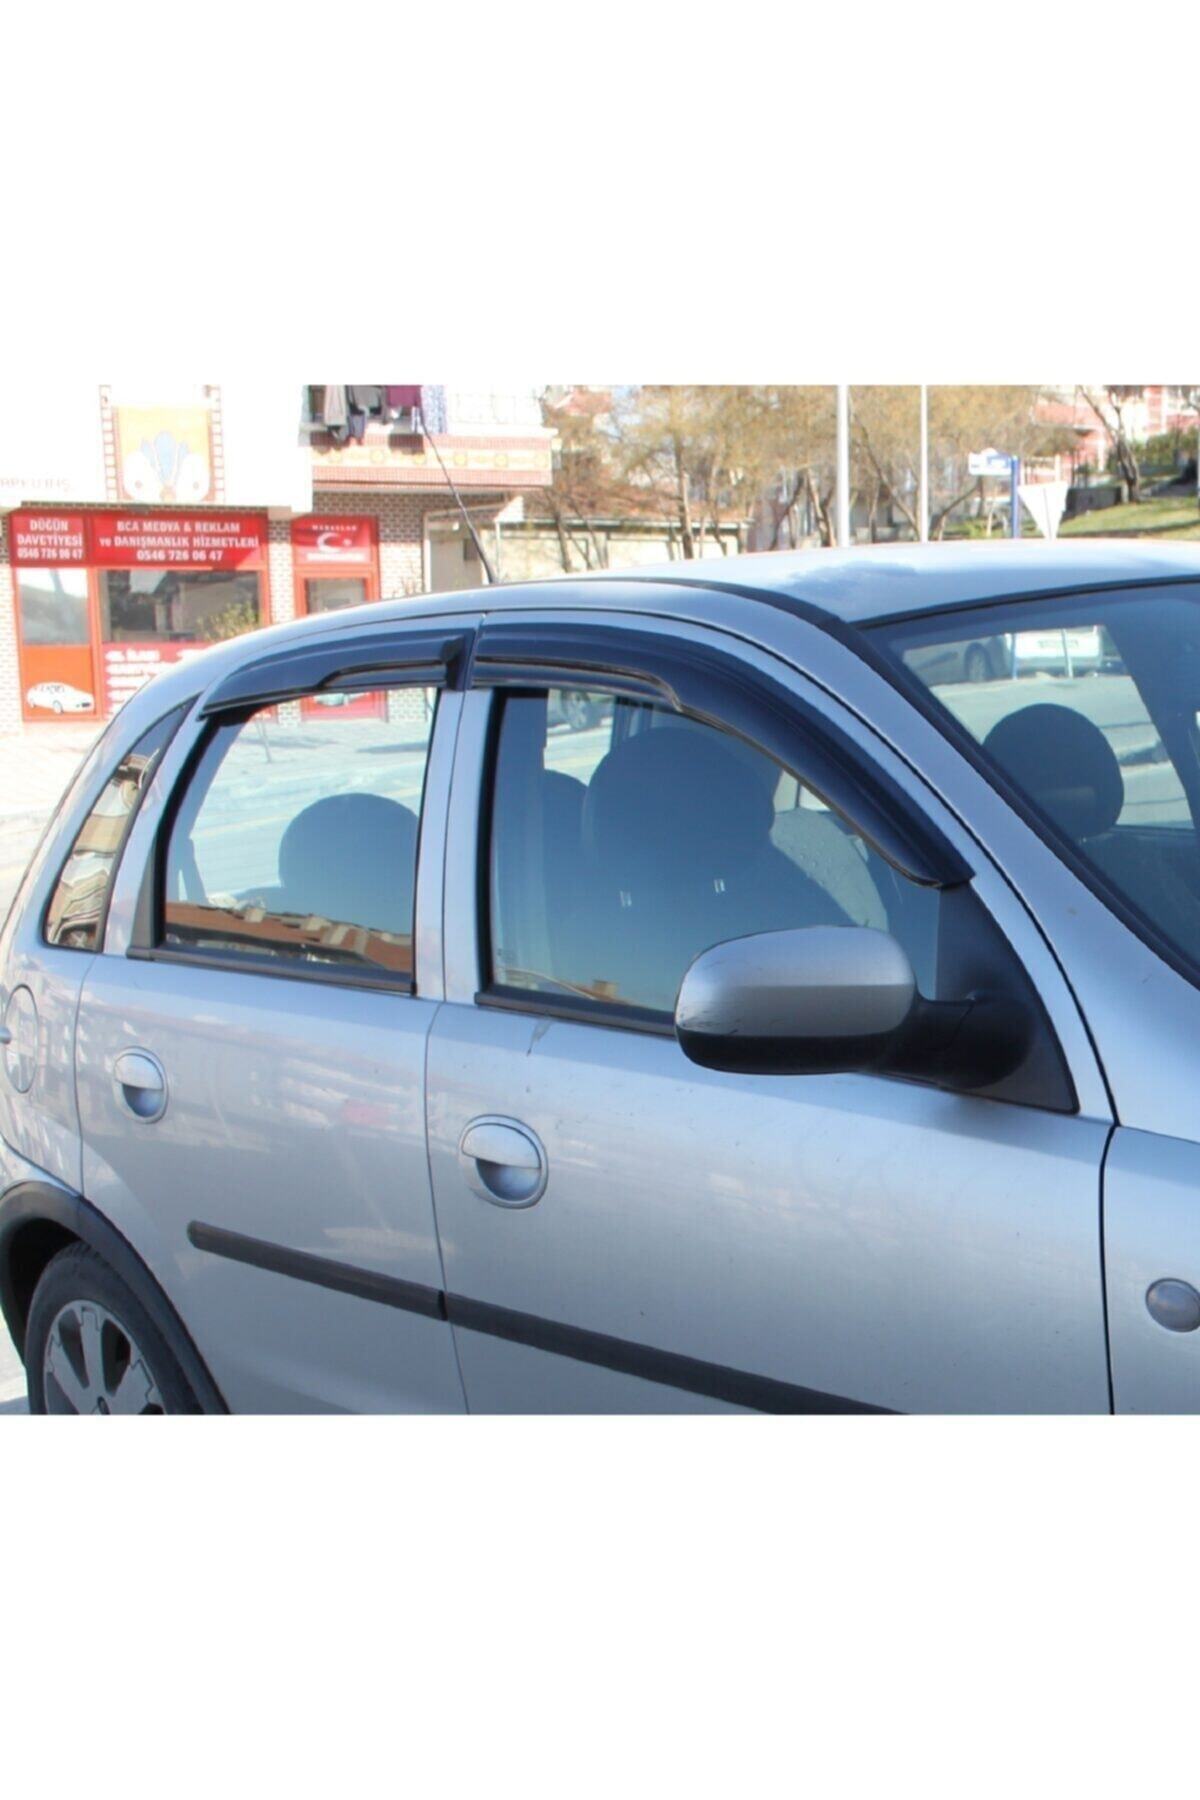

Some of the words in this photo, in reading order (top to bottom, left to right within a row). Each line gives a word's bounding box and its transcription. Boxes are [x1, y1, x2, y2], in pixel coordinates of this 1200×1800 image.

[143, 521, 180, 532] MEDYA
[195, 522, 240, 533] REKLAM
[99, 537, 111, 547] ve
[114, 536, 189, 548] DANIŞMANLIK
[193, 535, 259, 548] HİZMETLERİ
[136, 550, 166, 561] 0546
[169, 550, 189, 561] 726
[192, 550, 205, 561] 06
[208, 550, 223, 561] 47
